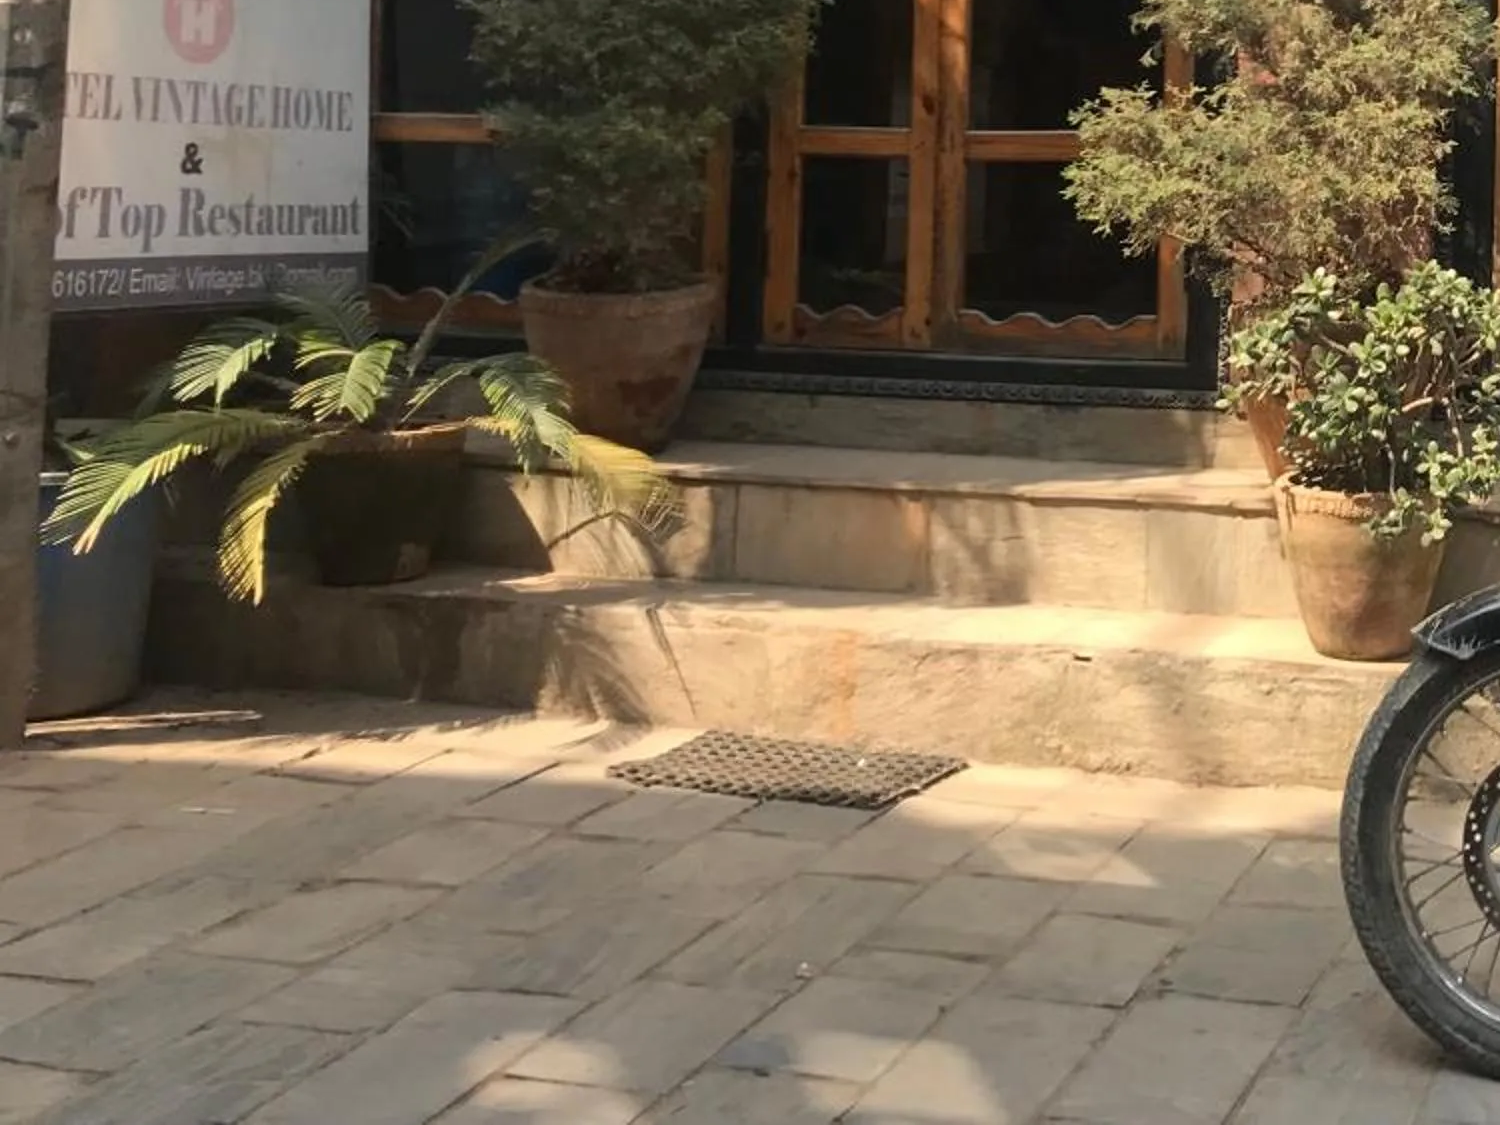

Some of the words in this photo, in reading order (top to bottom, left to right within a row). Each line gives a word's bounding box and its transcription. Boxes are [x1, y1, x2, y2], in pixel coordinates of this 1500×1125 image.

[132, 76, 266, 130] VINTAGE
[271, 86, 353, 133] HOME
[180, 141, 204, 175] &
[176, 187, 362, 239] Restaurant
